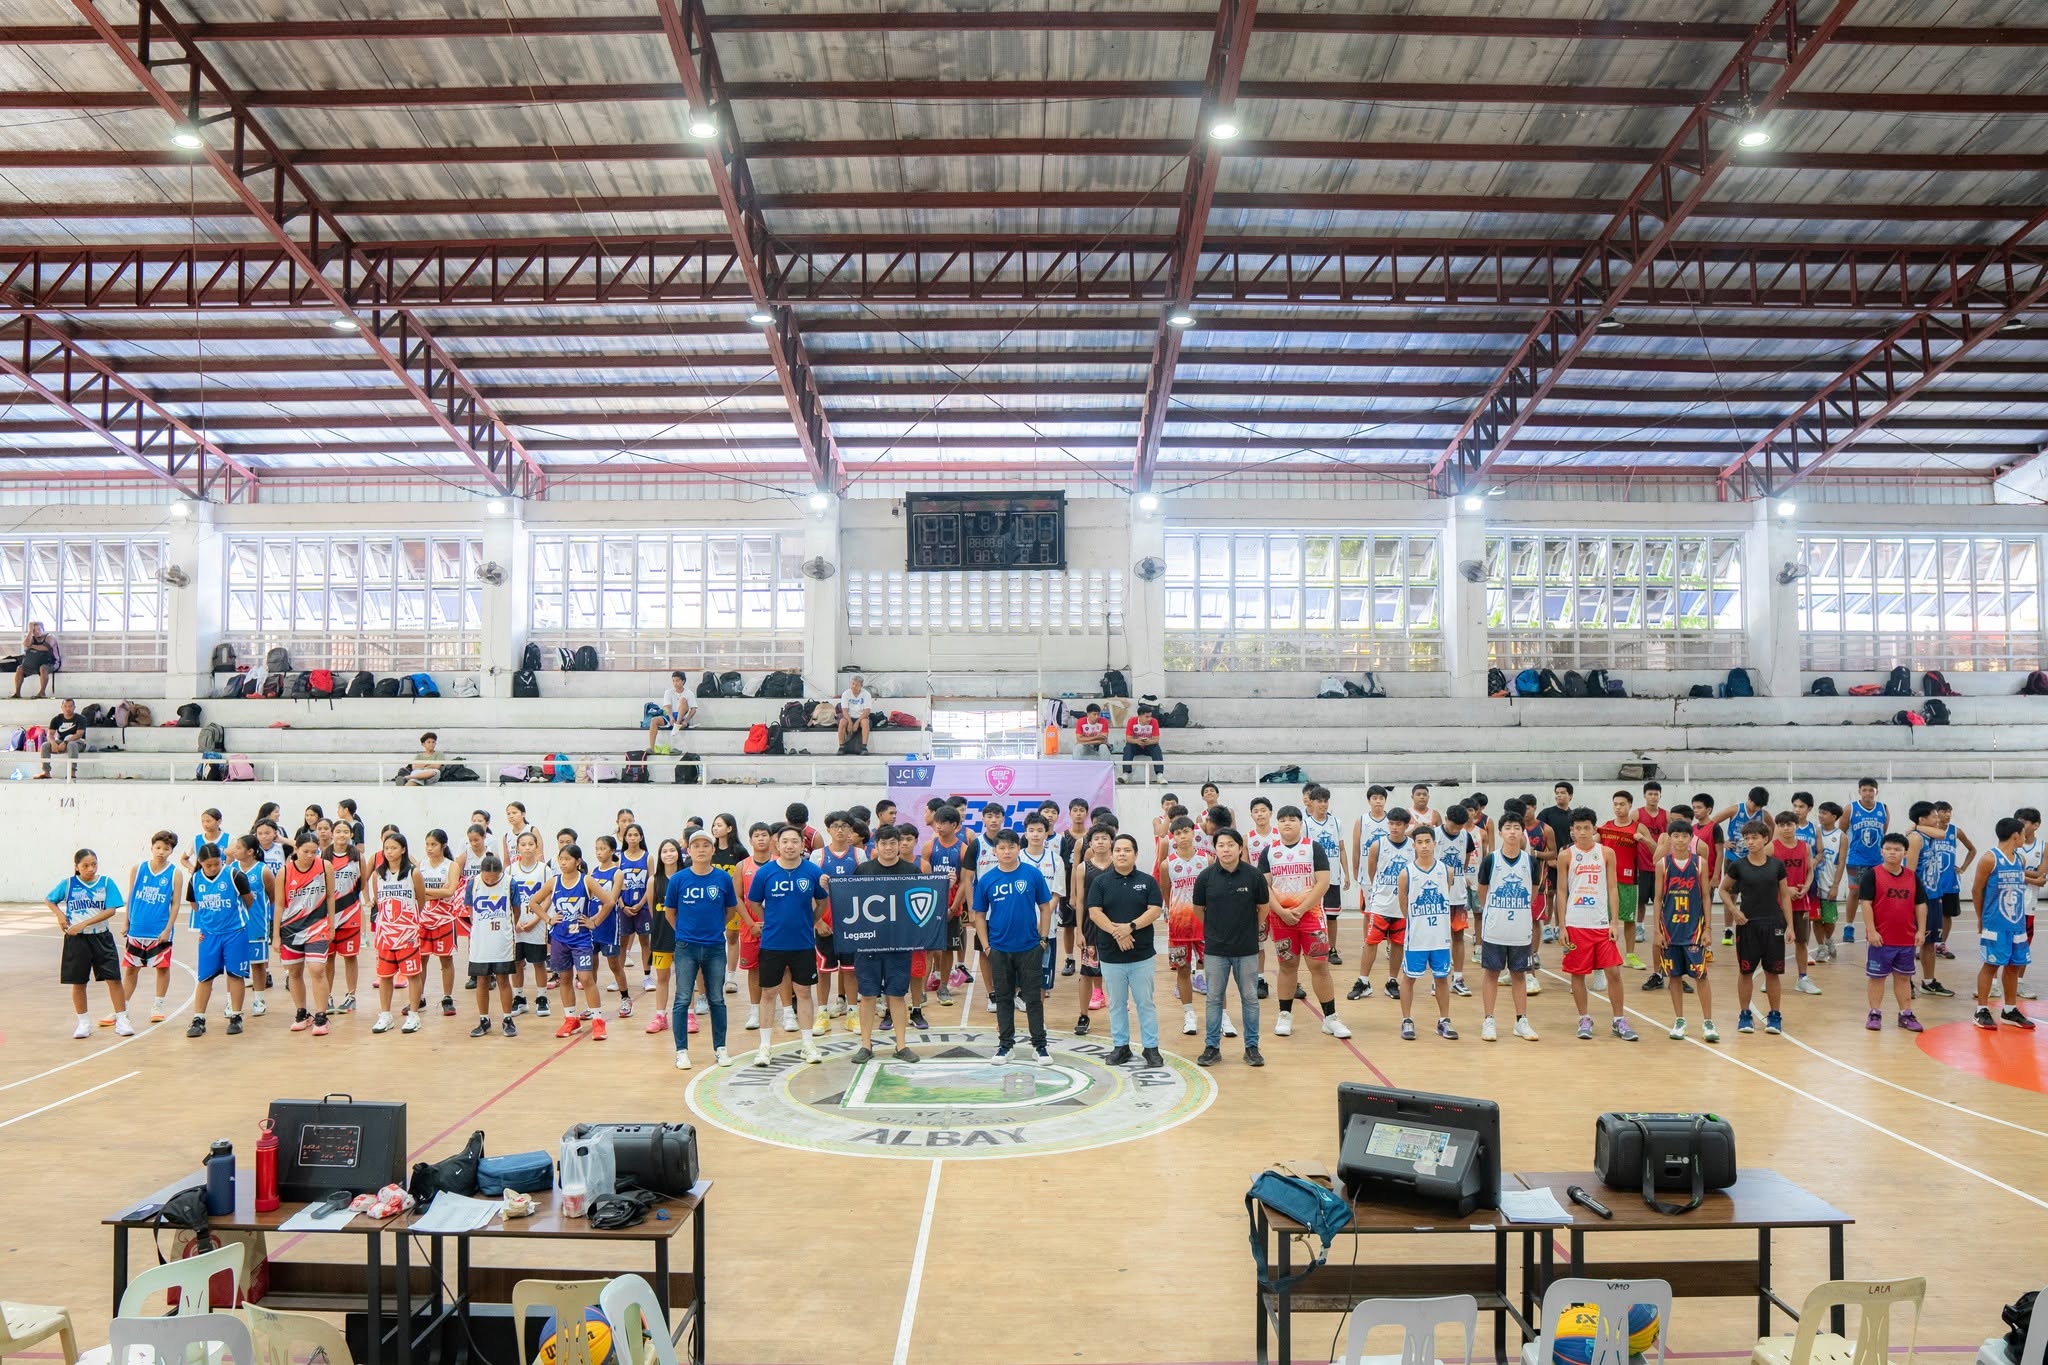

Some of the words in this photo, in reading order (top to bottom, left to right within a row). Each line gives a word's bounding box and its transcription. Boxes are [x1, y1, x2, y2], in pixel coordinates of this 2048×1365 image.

[896, 769, 914, 779] JCI
[1271, 864, 1312, 876] ZOOMWORKS
[771, 880, 794, 892] JCI
[993, 883, 1013, 896] JCI
[377, 889, 412, 899] EFENDERS
[683, 887, 704, 899] JCI
[1573, 896, 1596, 905] APG
[1674, 897, 1689, 911] 14
[842, 895, 897, 925] JCI
[1508, 911, 1514, 920] 2
[490, 921, 501, 931] 16
[645, 922, 650, 931] 8
[1427, 916, 1438, 927] 12
[843, 930, 877, 941] Legazpi
[346, 940, 354, 952] 6
[437, 941, 444, 952] 5
[406, 960, 417, 972] 21
[579, 955, 592, 967] 22
[851, 1126, 1028, 1148] ALBAY
[1606, 1283, 1630, 1291] VMO
